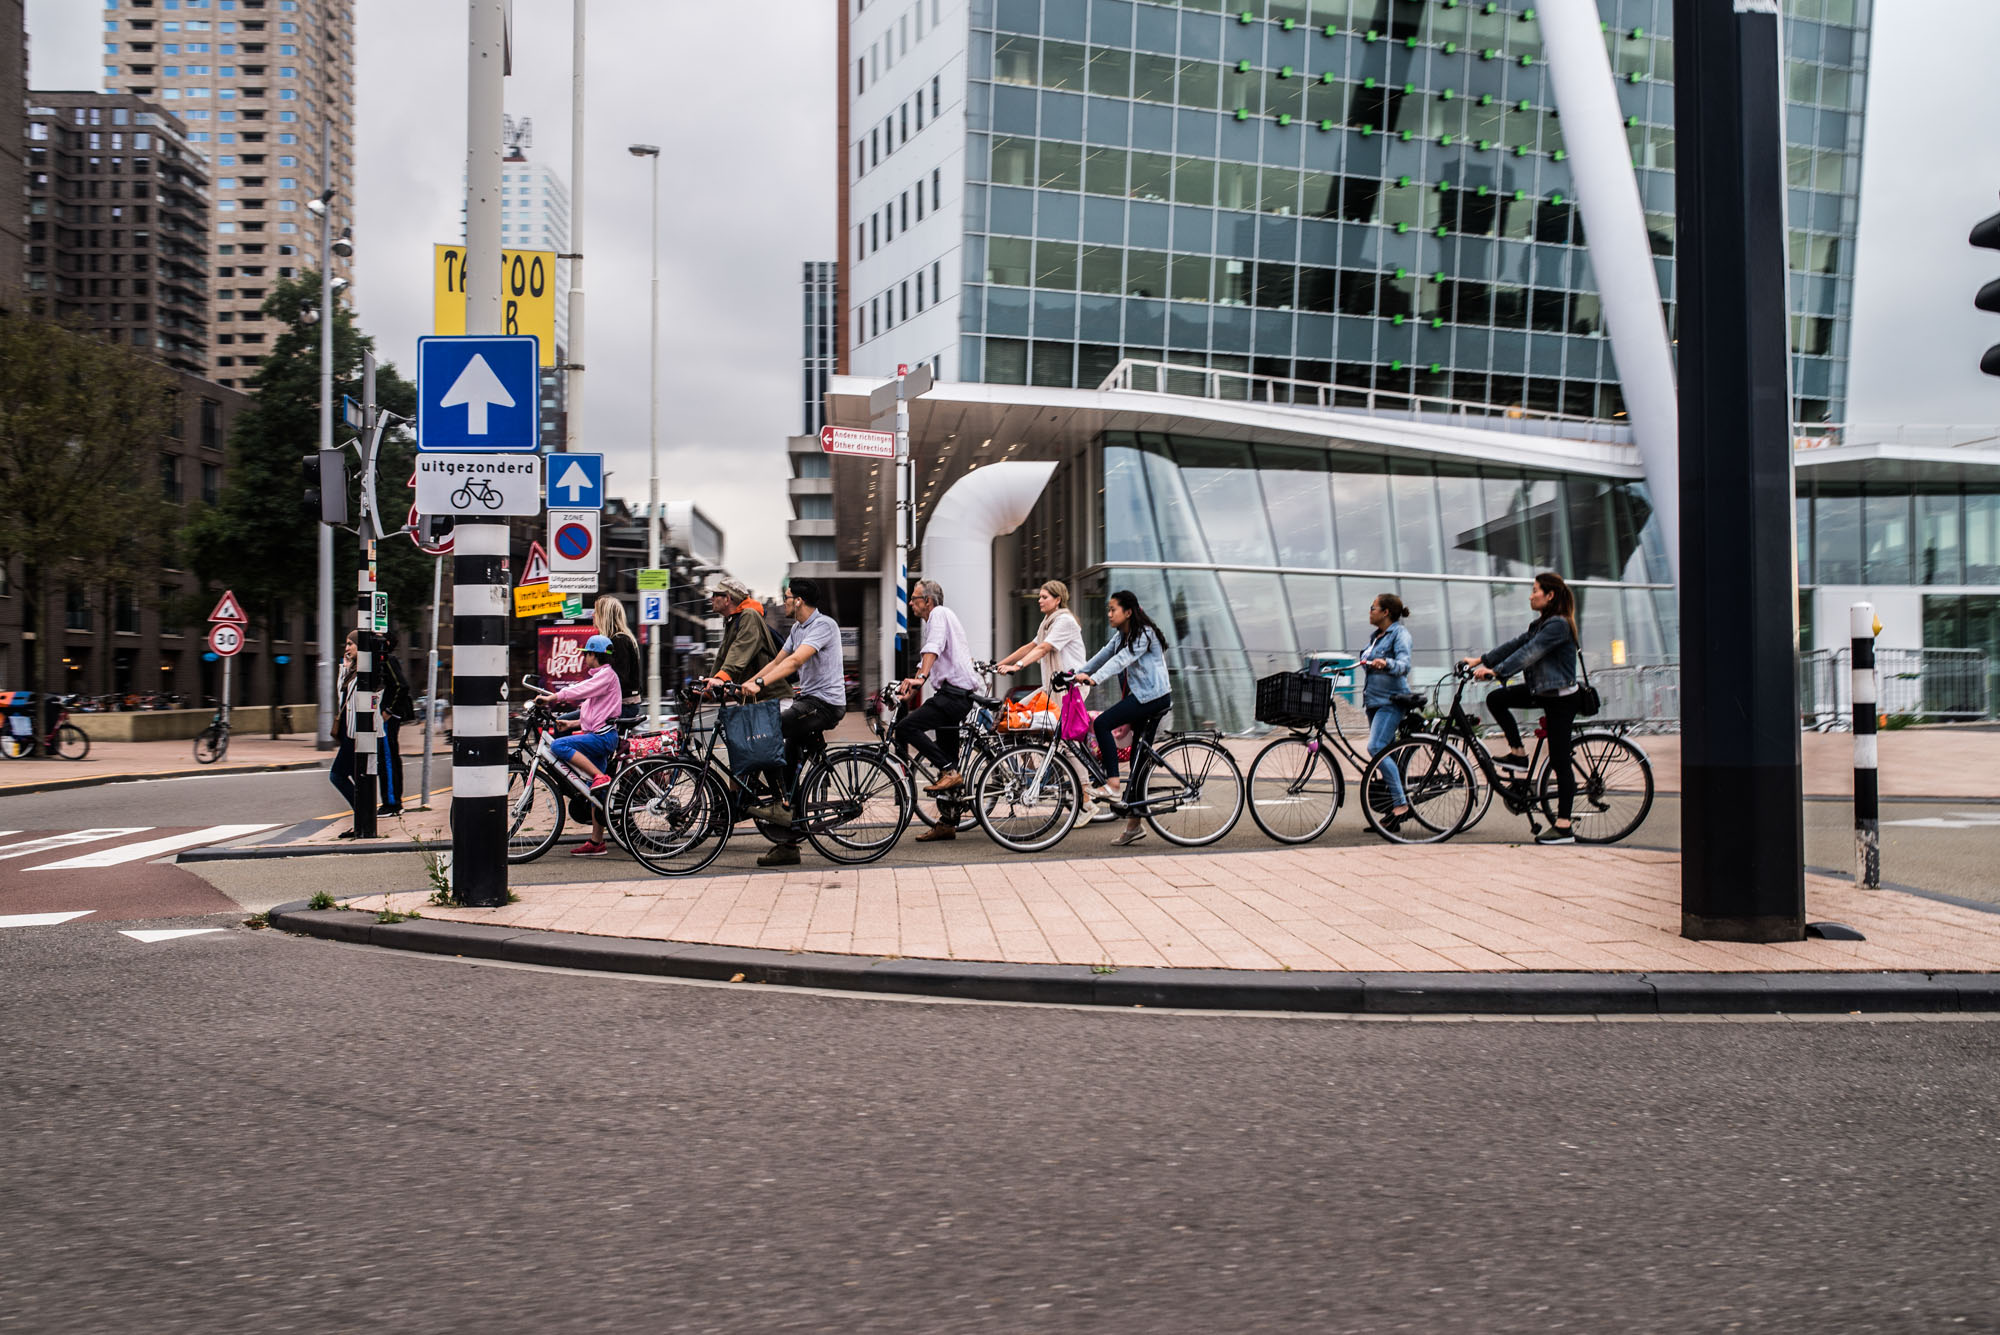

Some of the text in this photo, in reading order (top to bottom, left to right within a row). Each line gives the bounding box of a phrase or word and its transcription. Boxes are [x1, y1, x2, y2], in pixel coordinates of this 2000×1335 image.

[444, 250, 545, 297] TOO
[834, 431, 892, 444] Andere richtingen
[834, 441, 892, 453] Other directions
[421, 460, 534, 476] uitgezonderd
[216, 633, 238, 646] 30
